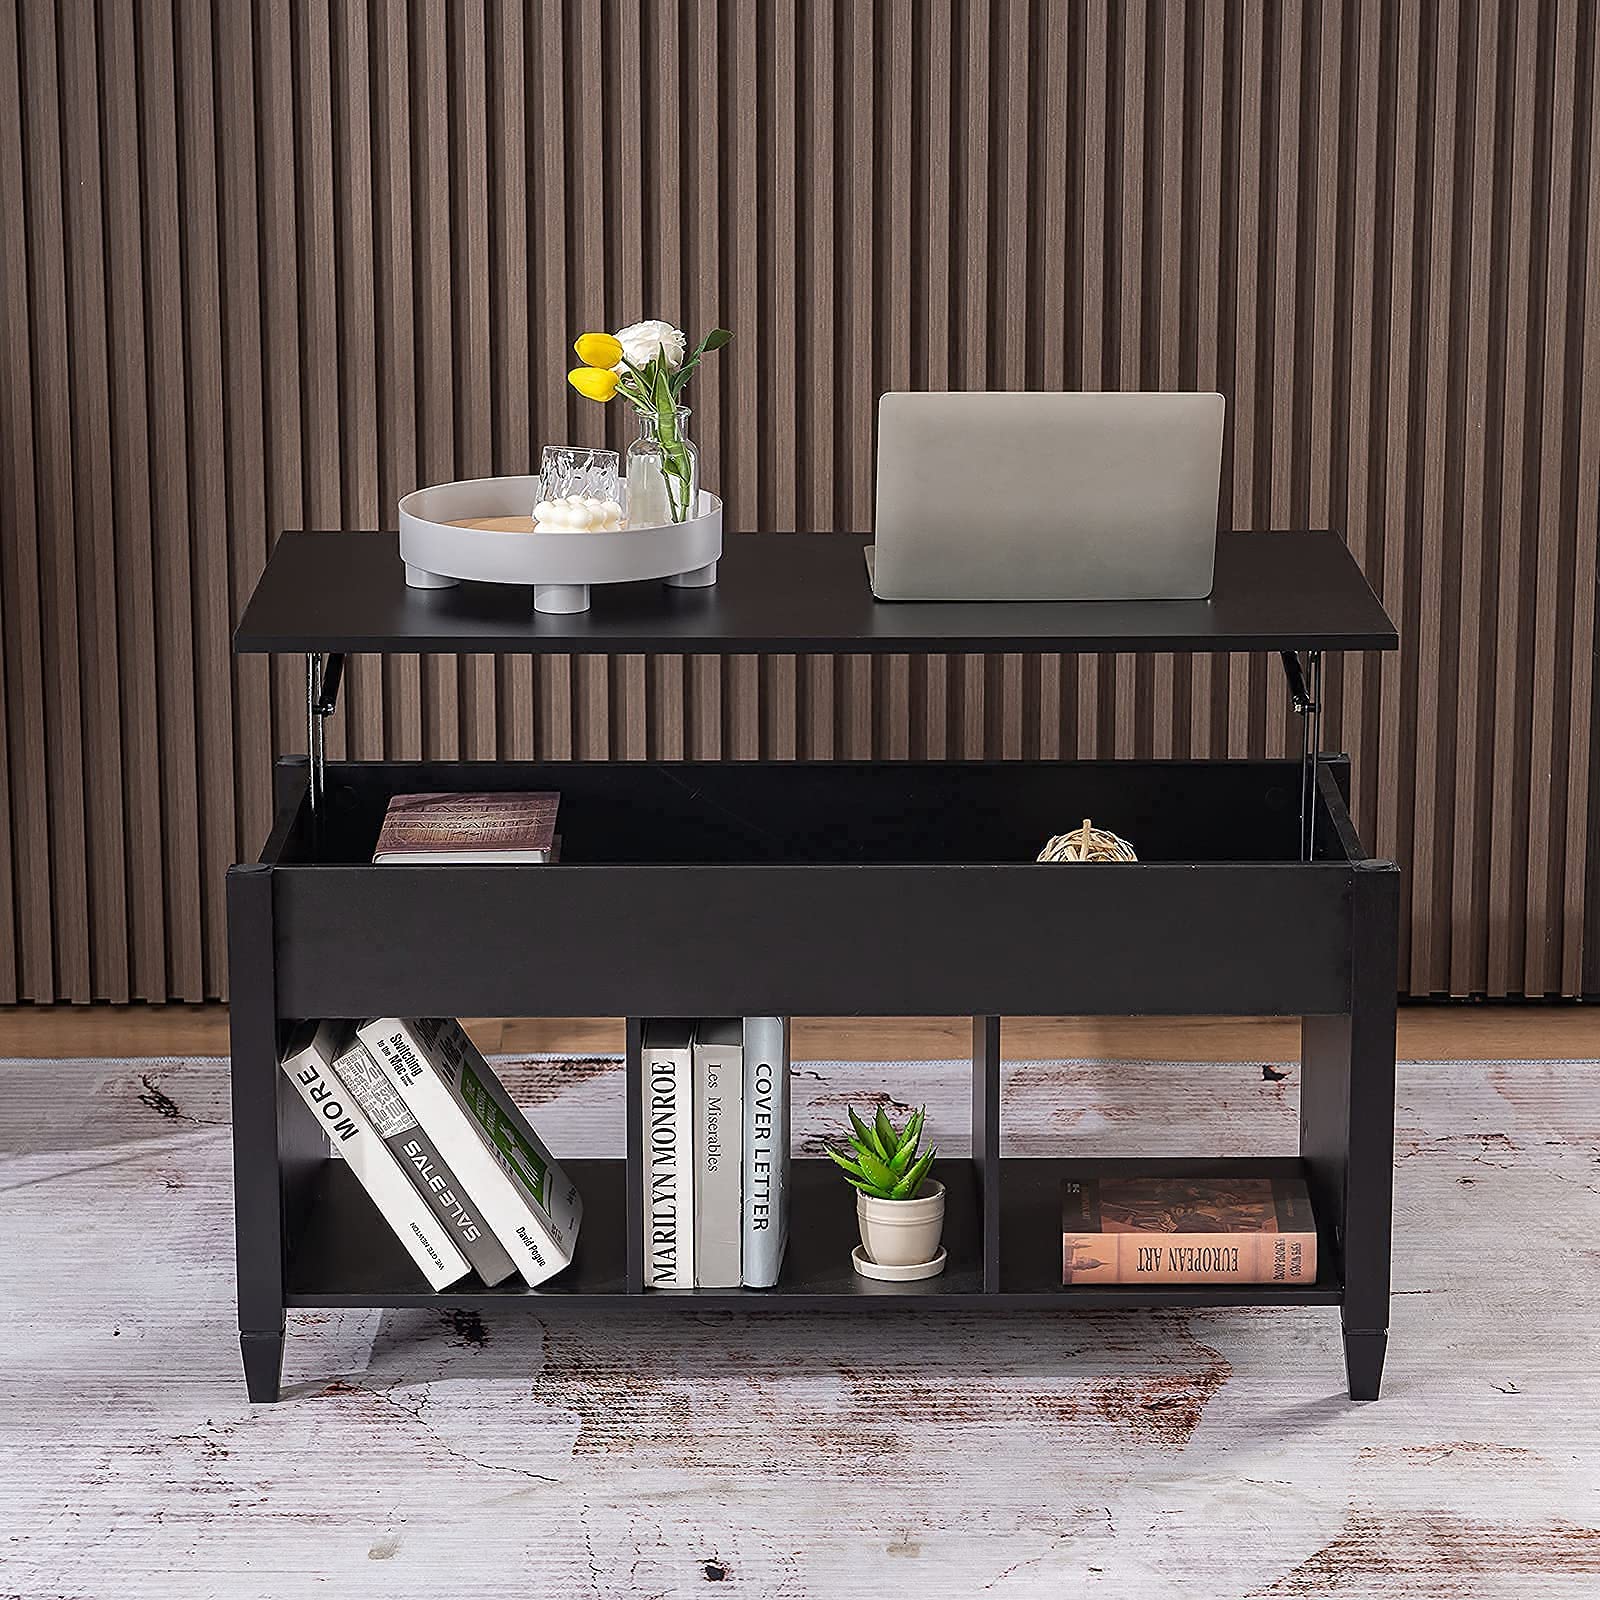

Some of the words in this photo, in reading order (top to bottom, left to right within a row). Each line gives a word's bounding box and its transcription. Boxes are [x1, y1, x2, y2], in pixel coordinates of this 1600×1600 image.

[376, 1039, 386, 1048] to
[381, 1045, 392, 1057] the
[387, 1053, 407, 1076] Mac
[389, 1032, 424, 1078] Switching
[707, 1063, 722, 1089] Les
[296, 1064, 360, 1142] MORE
[649, 1061, 677, 1166] MONROE
[754, 1063, 773, 1140] COVER
[707, 1097, 722, 1172] Miserables
[753, 1148, 772, 1232] LETTER
[516, 1226, 535, 1250] David
[528, 1244, 546, 1268] Pogue
[650, 1172, 677, 1284] MARILYN
[1136, 1247, 1163, 1273] ART
[1167, 1247, 1239, 1273] EUROPEAN
